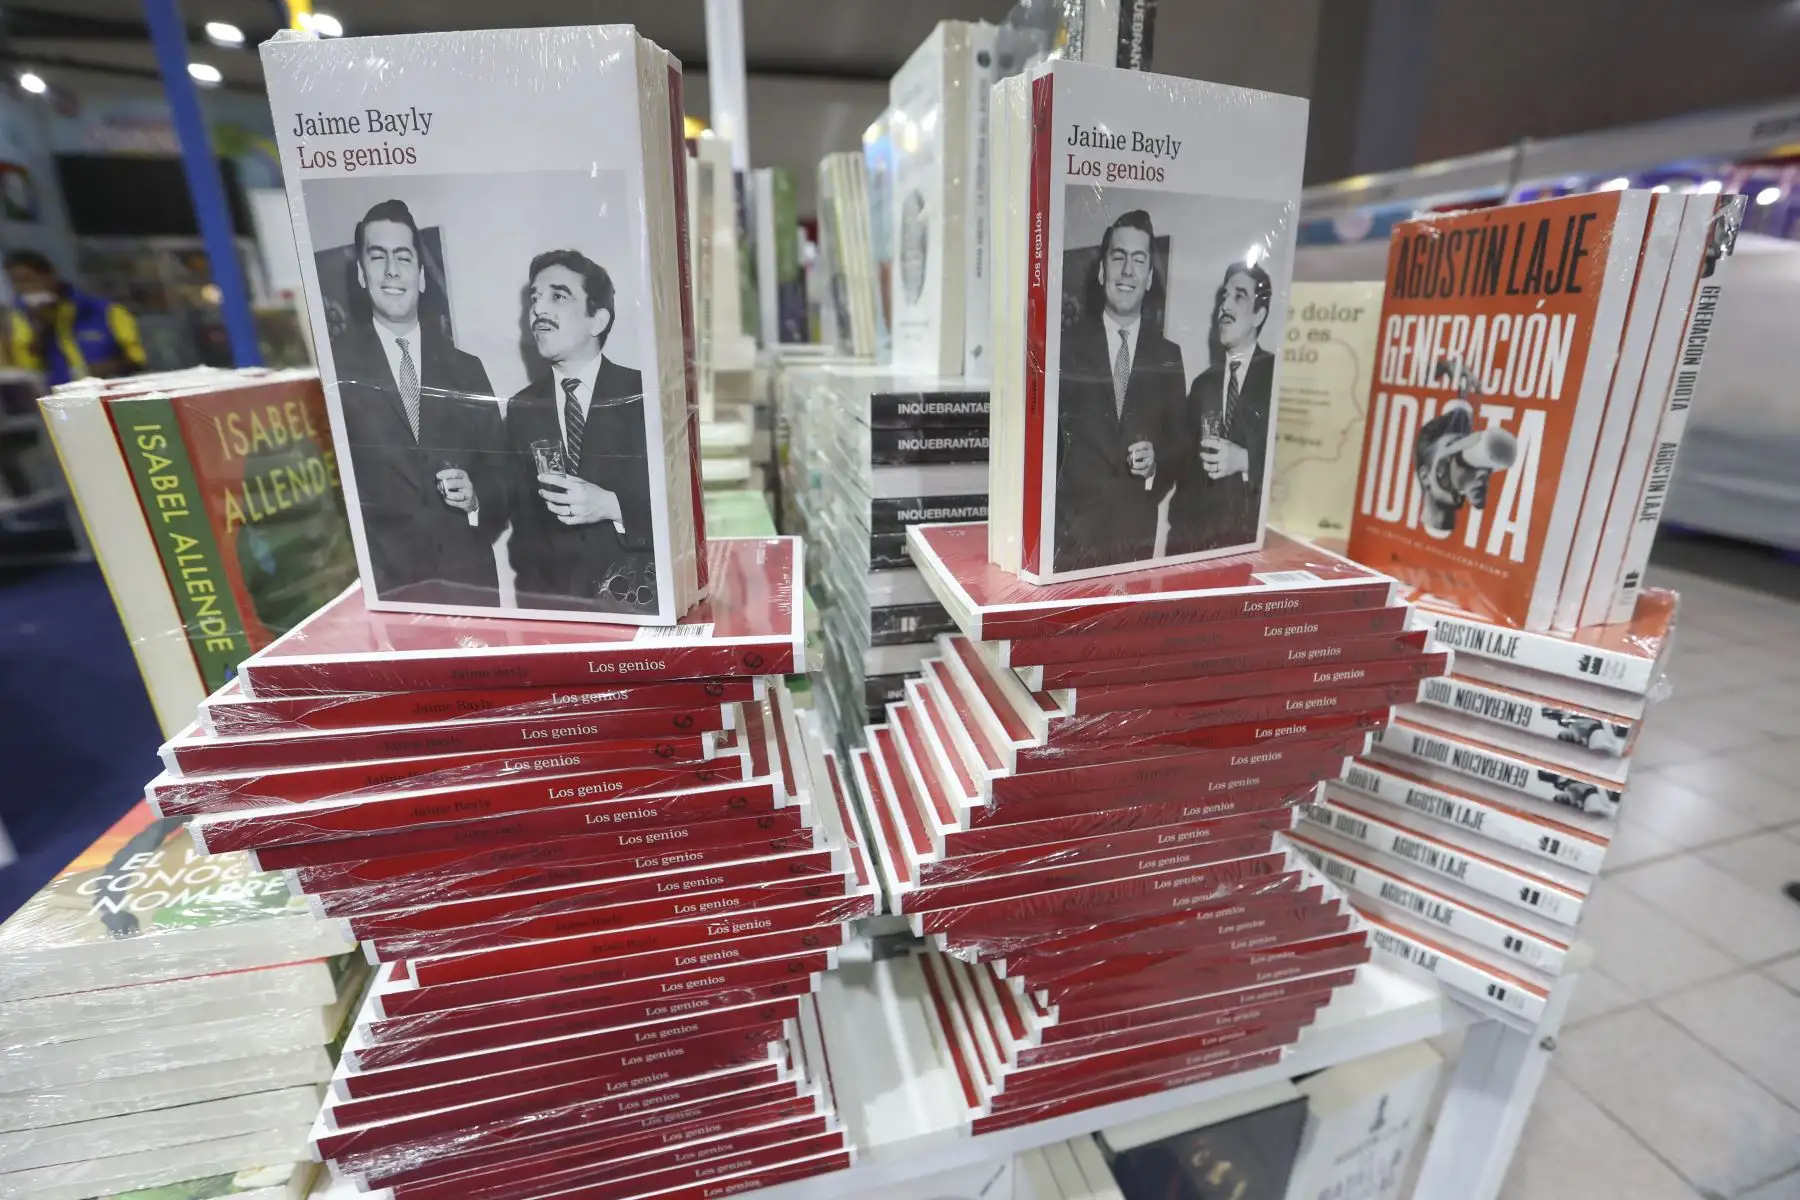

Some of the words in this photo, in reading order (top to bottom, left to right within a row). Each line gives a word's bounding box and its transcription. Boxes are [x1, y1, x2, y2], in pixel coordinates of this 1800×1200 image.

[293, 112, 361, 137] Jaime
[365, 107, 433, 136] Bayly
[1067, 124, 1126, 150] Jaime
[1131, 131, 1182, 160] Bayly
[297, 146, 337, 169] Los
[343, 141, 417, 171] genios
[1066, 153, 1101, 176] Los
[1106, 160, 1165, 182] genios
[1034, 211, 1043, 259] genios
[1393, 210, 1504, 300] AGUSTÍN
[1504, 212, 1597, 296] LAJE
[1033, 262, 1041, 288] Los
[1301, 302, 1364, 323] dolor
[1307, 327, 1332, 342] es
[1379, 300, 1577, 401] GENERACIÓN
[1670, 371, 1698, 412] IDIOTA
[213, 401, 318, 460] ISABEL
[224, 451, 340, 533] ALLENDE
[897, 506, 988, 521] INQUEBRANTAB
[1639, 495, 1663, 523] LAJE
[133, 424, 190, 523] ISABEL
[169, 531, 235, 652] ALLENDE
[1243, 601, 1262, 611] Los
[1265, 598, 1299, 611] genios
[1264, 627, 1282, 636] Los
[1284, 623, 1318, 636] genios
[1288, 650, 1305, 659] Los
[1308, 646, 1340, 659] genios
[1486, 631, 1520, 658] LAJE
[588, 662, 614, 672] Los
[618, 658, 665, 673] genios
[1313, 673, 1330, 682] Los
[1332, 668, 1364, 681] genios
[552, 693, 577, 704] Los
[581, 689, 627, 703] genios
[1286, 700, 1302, 709] Los
[1305, 696, 1336, 709] genios
[521, 729, 547, 739] Los
[551, 724, 597, 738] genios
[1255, 729, 1272, 737] Los
[1274, 724, 1306, 736] genios
[1412, 735, 1449, 763] IDIOTA
[504, 761, 529, 770] Los
[534, 755, 580, 770] genios
[1231, 756, 1247, 765] Los
[1250, 751, 1281, 764] genios
[548, 789, 573, 798] Los
[577, 781, 622, 796] genios
[1208, 782, 1225, 790] Los
[1227, 776, 1259, 789] genios
[585, 814, 609, 824] Los
[613, 808, 657, 822] genios
[1183, 807, 1200, 816] Los
[1202, 801, 1234, 814] genios
[1454, 810, 1487, 831] LAJE
[618, 836, 642, 845] Los
[645, 829, 688, 843] genios
[1158, 834, 1175, 843] Los
[1177, 828, 1209, 841] genios
[120, 851, 164, 871] EL
[635, 858, 658, 867] Los
[662, 852, 703, 865] genios
[1158, 854, 1190, 866] genios
[1440, 851, 1469, 881] LAJE
[76, 865, 264, 896] CONOC
[657, 883, 679, 892] Los
[683, 876, 723, 889] genios
[1154, 881, 1170, 889] Los
[1173, 874, 1204, 886] genios
[674, 904, 696, 913] Los
[699, 898, 739, 911] genios
[1426, 899, 1456, 926] LAJE
[707, 926, 729, 935] Los
[732, 919, 771, 932] genios
[675, 956, 696, 965] Los
[700, 949, 739, 963] genios
[1374, 930, 1410, 960] GUSTIN
[1412, 948, 1440, 973] LAJE
[661, 983, 683, 992] Los
[686, 976, 725, 989] genios
[646, 1007, 667, 1016] Los
[670, 999, 708, 1012] genios
[635, 1032, 656, 1041] Los
[659, 1024, 698, 1038] genios
[621, 1056, 642, 1065] Los
[645, 1047, 684, 1062] genios
[606, 1081, 628, 1091] Los
[630, 1070, 669, 1086] genios
[618, 1101, 639, 1111] Los
[642, 1091, 680, 1106] genios
